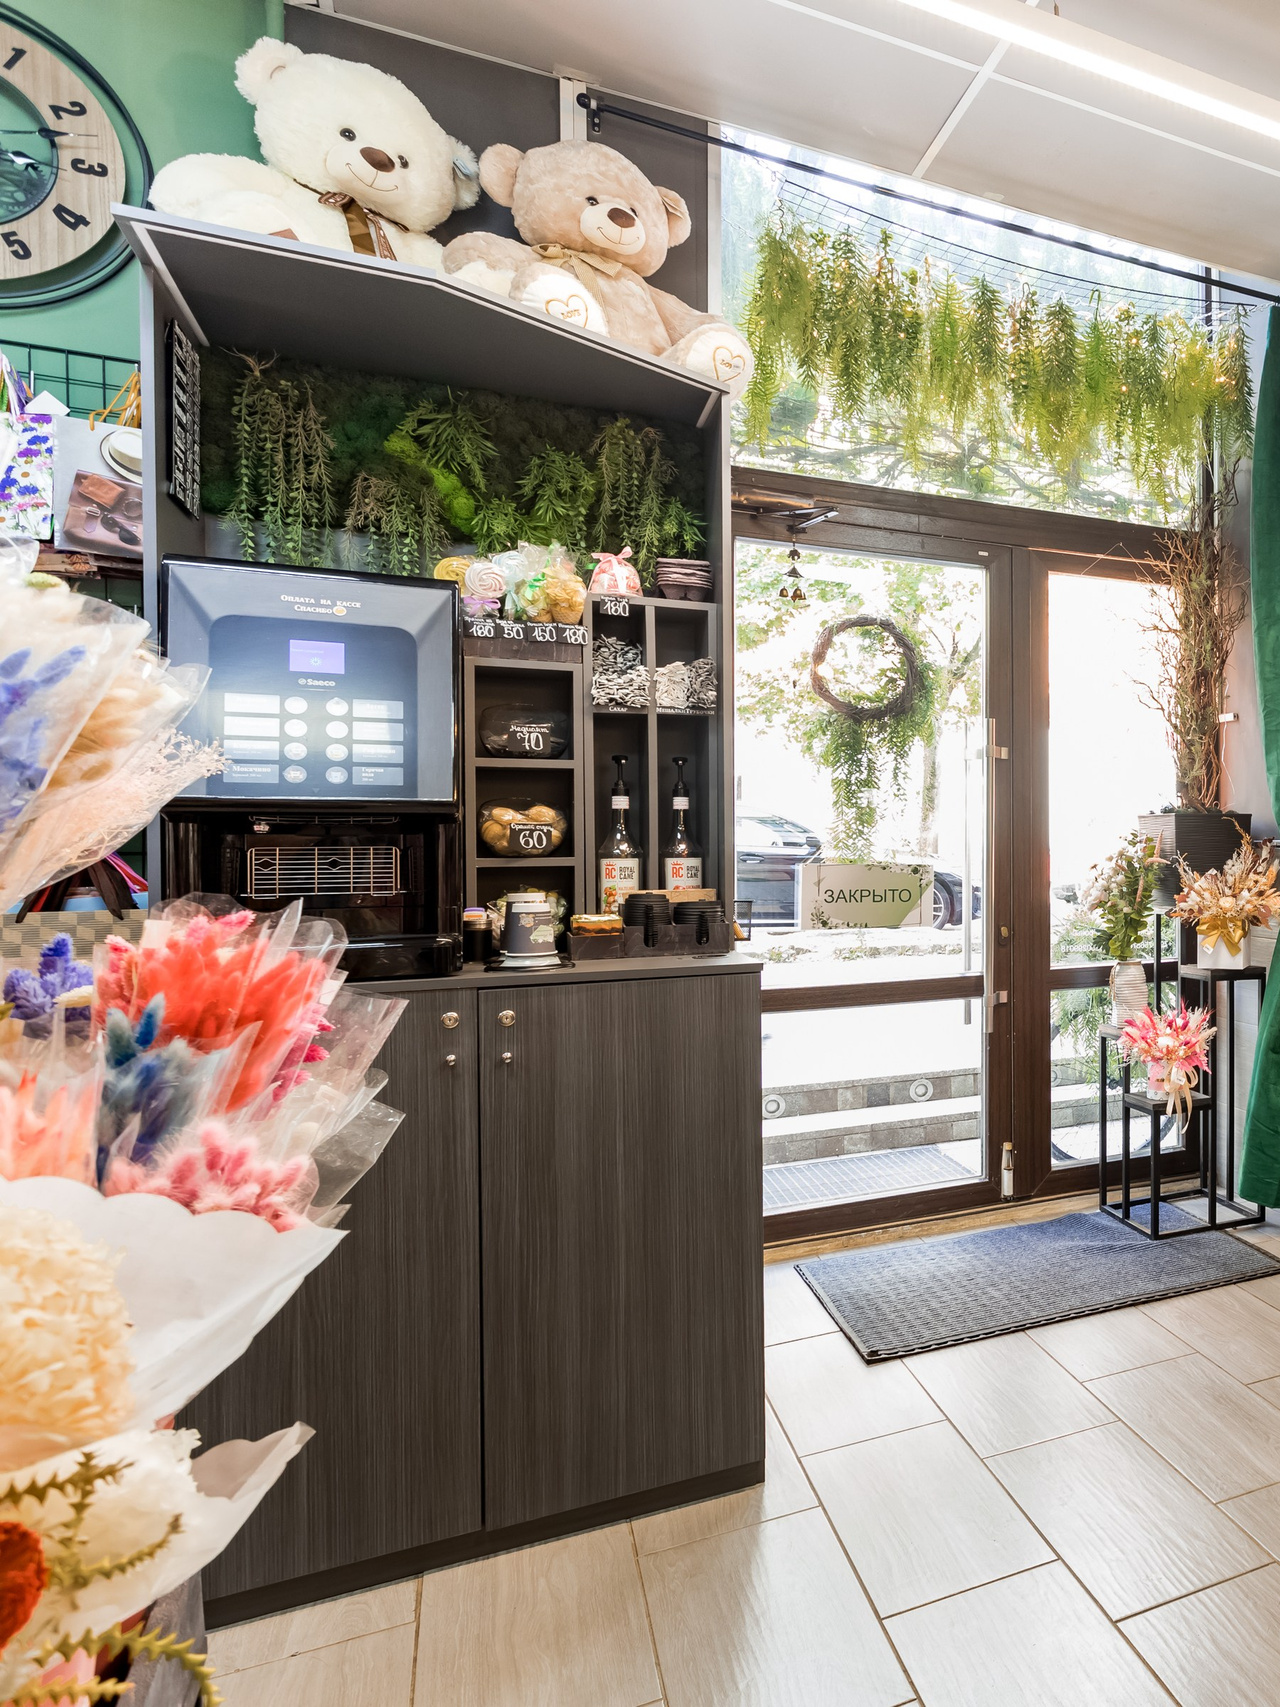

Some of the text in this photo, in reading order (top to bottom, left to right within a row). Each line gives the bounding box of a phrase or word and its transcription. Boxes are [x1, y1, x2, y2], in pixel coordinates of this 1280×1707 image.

[3, 47, 27, 70] 1
[49, 101, 87, 120] 2
[71, 158, 108, 178] 3
[53, 203, 91, 231] 4
[1, 231, 32, 260] 5
[603, 600, 629, 617] 180
[469, 624, 494, 638] 180
[503, 626, 524, 640] 50
[532, 626, 557, 642] 150
[562, 628, 588, 645] 180
[306, 678, 336, 687] Saeco
[516, 732, 544, 751] 70
[519, 830, 547, 849] 60
[604, 867, 616, 879] RC
[671, 866, 684, 879] RC
[823, 888, 912, 904] ЗАКРЫТО
